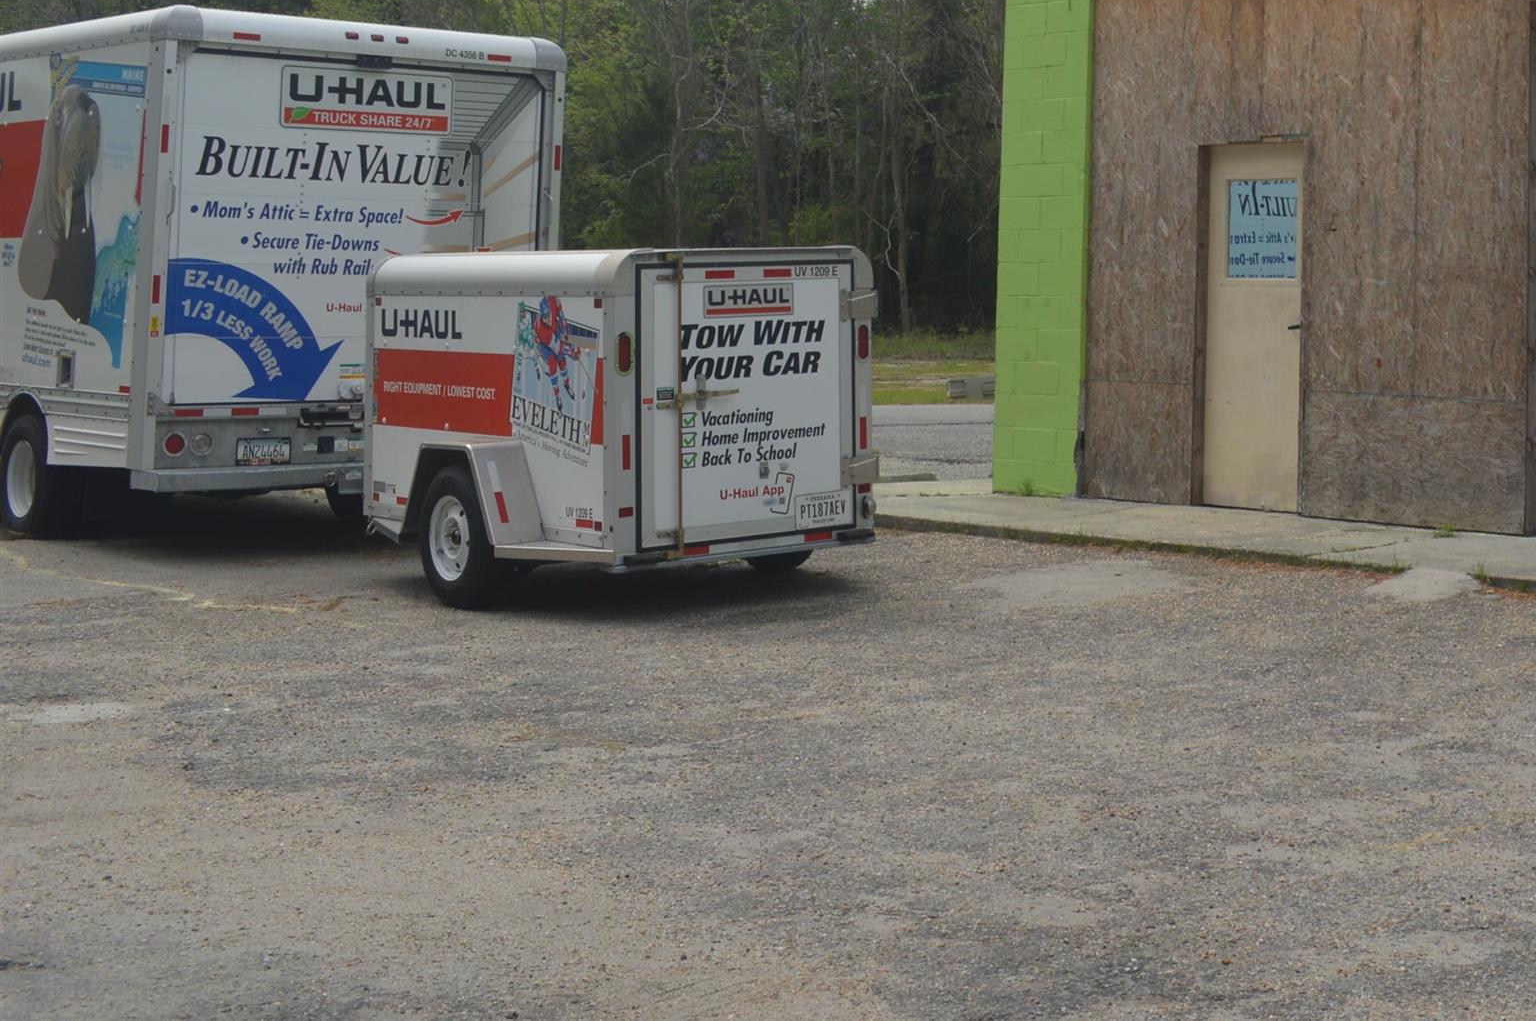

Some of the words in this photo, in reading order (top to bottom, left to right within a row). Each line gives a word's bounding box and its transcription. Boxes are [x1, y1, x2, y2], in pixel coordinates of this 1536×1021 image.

[445, 48, 457, 58] DC
[459, 49, 478, 60] 4356
[289, 73, 446, 110] U-HAUL
[313, 111, 357, 125] TRUCK
[360, 113, 403, 127] SHARE
[405, 117, 432, 129] 24/7
[195, 135, 352, 182] BUILT-IN
[202, 200, 255, 220] Mom's
[259, 202, 295, 221] Attic
[314, 204, 355, 223] Extra
[359, 208, 404, 228] Space!
[252, 231, 299, 251] Secure
[304, 233, 379, 252] Tie-Downs
[273, 256, 306, 275] with
[311, 257, 338, 276] Rub
[342, 259, 374, 276] Rail
[794, 267, 807, 277] UV
[810, 266, 830, 277] 1209
[832, 266, 838, 276] E
[707, 287, 790, 307] U-HAUL
[183, 269, 264, 309] EZ-LOAD
[259, 301, 304, 350] RAMP
[326, 303, 363, 313] U-Haul
[381, 308, 463, 339] U-HAUL
[181, 298, 215, 321] 1/3
[215, 310, 254, 341] LESS
[250, 335, 283, 381] WORK
[681, 323, 745, 350] TOW
[754, 320, 825, 346] WITH
[681, 355, 754, 382] YOUR
[762, 350, 821, 376] CAR
[383, 381, 403, 393] RIGHT
[404, 382, 442, 396] EQUIPMENT
[447, 386, 476, 398] LOWEST
[476, 387, 496, 400] COST
[511, 395, 582, 445] EVELETH
[701, 408, 774, 427] Vacationing
[701, 431, 739, 447] Home
[743, 423, 826, 446] Improvement
[242, 443, 285, 460] AN24464
[701, 451, 732, 467] Back
[737, 448, 751, 463] To
[756, 443, 797, 462] School
[719, 486, 759, 500] U-Haul
[762, 485, 785, 501] App
[565, 506, 574, 517] UV
[575, 507, 589, 519] 1209
[799, 499, 847, 520] PT187AEV
